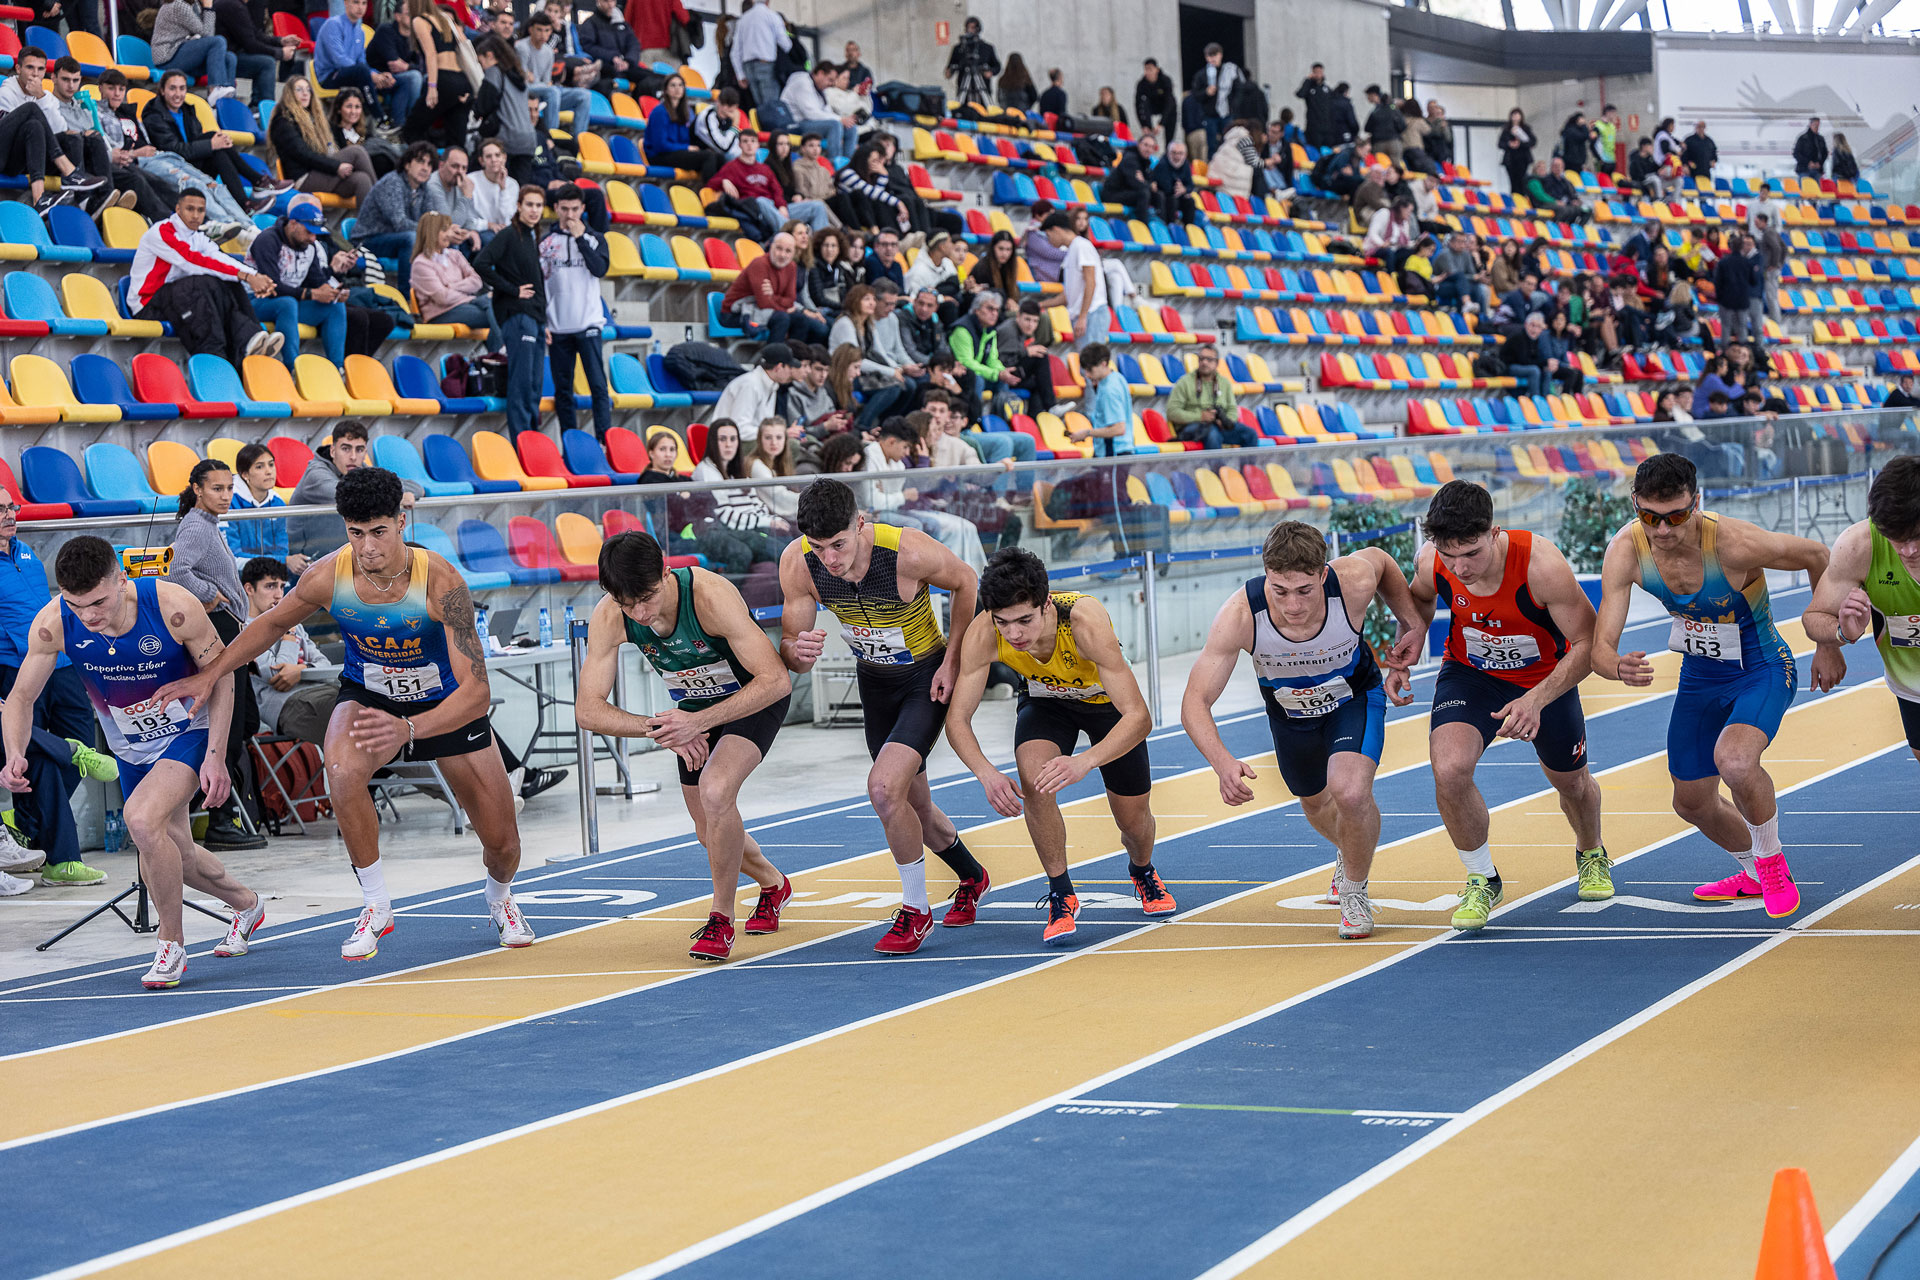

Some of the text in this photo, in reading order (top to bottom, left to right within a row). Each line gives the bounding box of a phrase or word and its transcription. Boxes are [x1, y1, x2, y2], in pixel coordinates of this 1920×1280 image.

[1481, 645, 1522, 661] 236
[1684, 638, 1722, 658] 153
[83, 661, 167, 673] Deportivo Eibar
[1481, 659, 1526, 670] Joma
[384, 679, 421, 695] 151
[681, 676, 718, 689] 101
[685, 686, 726, 697] Joma
[1297, 692, 1336, 709] 164
[131, 712, 171, 732] 193
[138, 724, 180, 742] Joma
